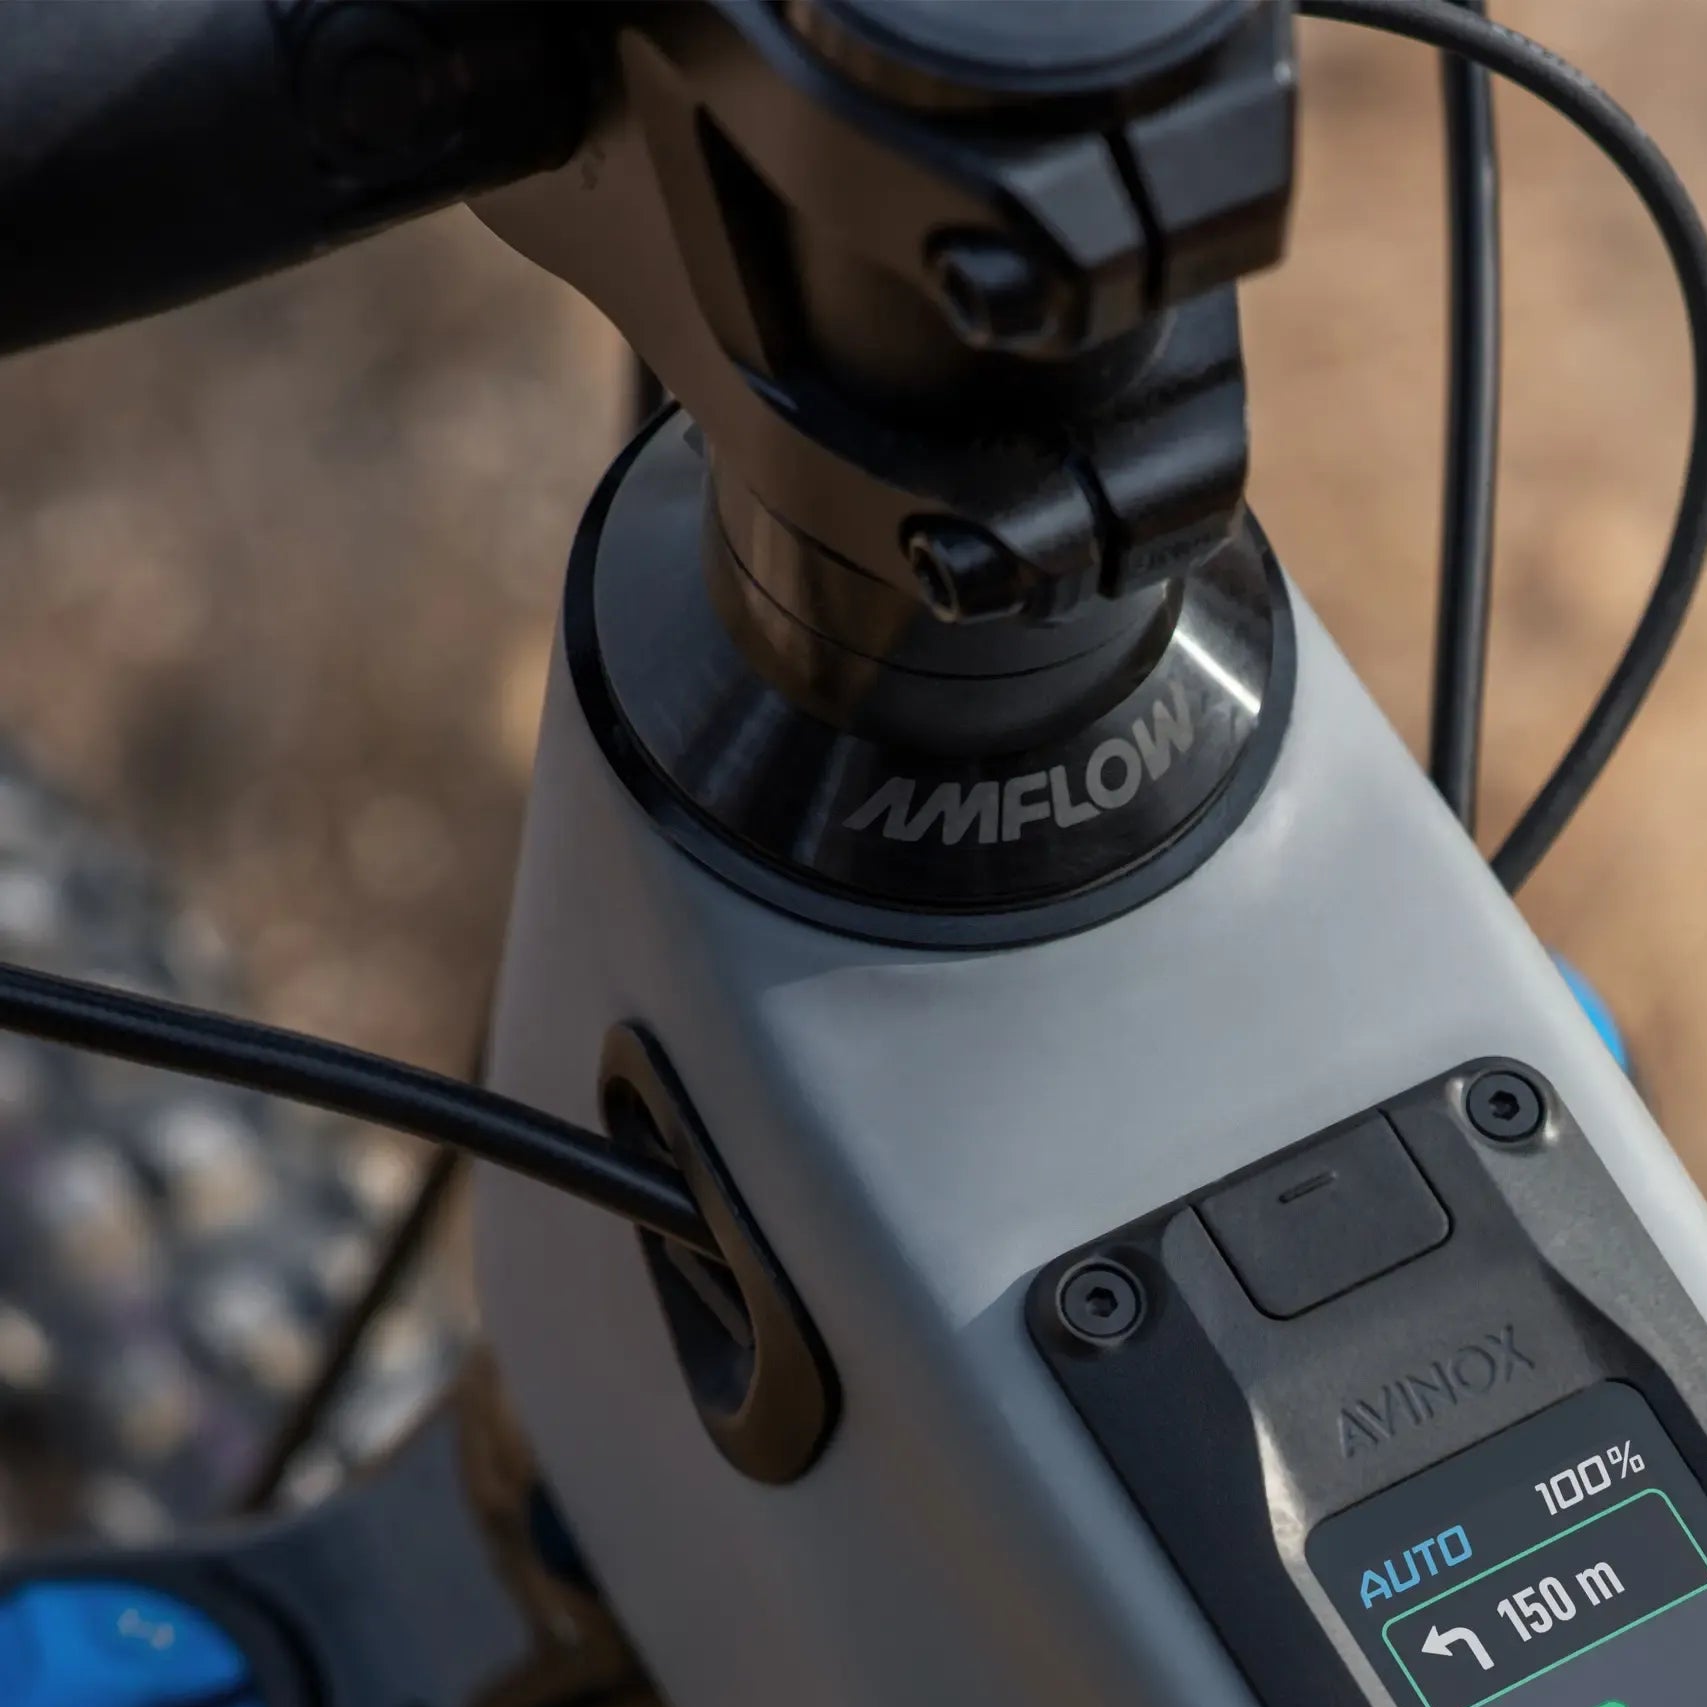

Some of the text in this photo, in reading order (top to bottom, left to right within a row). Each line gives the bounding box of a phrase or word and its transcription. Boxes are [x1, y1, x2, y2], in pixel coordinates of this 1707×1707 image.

[841, 680, 1194, 846] AMFLOW
[1337, 1324, 1536, 1459] AVINOX
[1535, 1440, 1646, 1516] 100%
[1359, 1524, 1473, 1609] AUTO
[1496, 1561, 1625, 1643] 150 m
